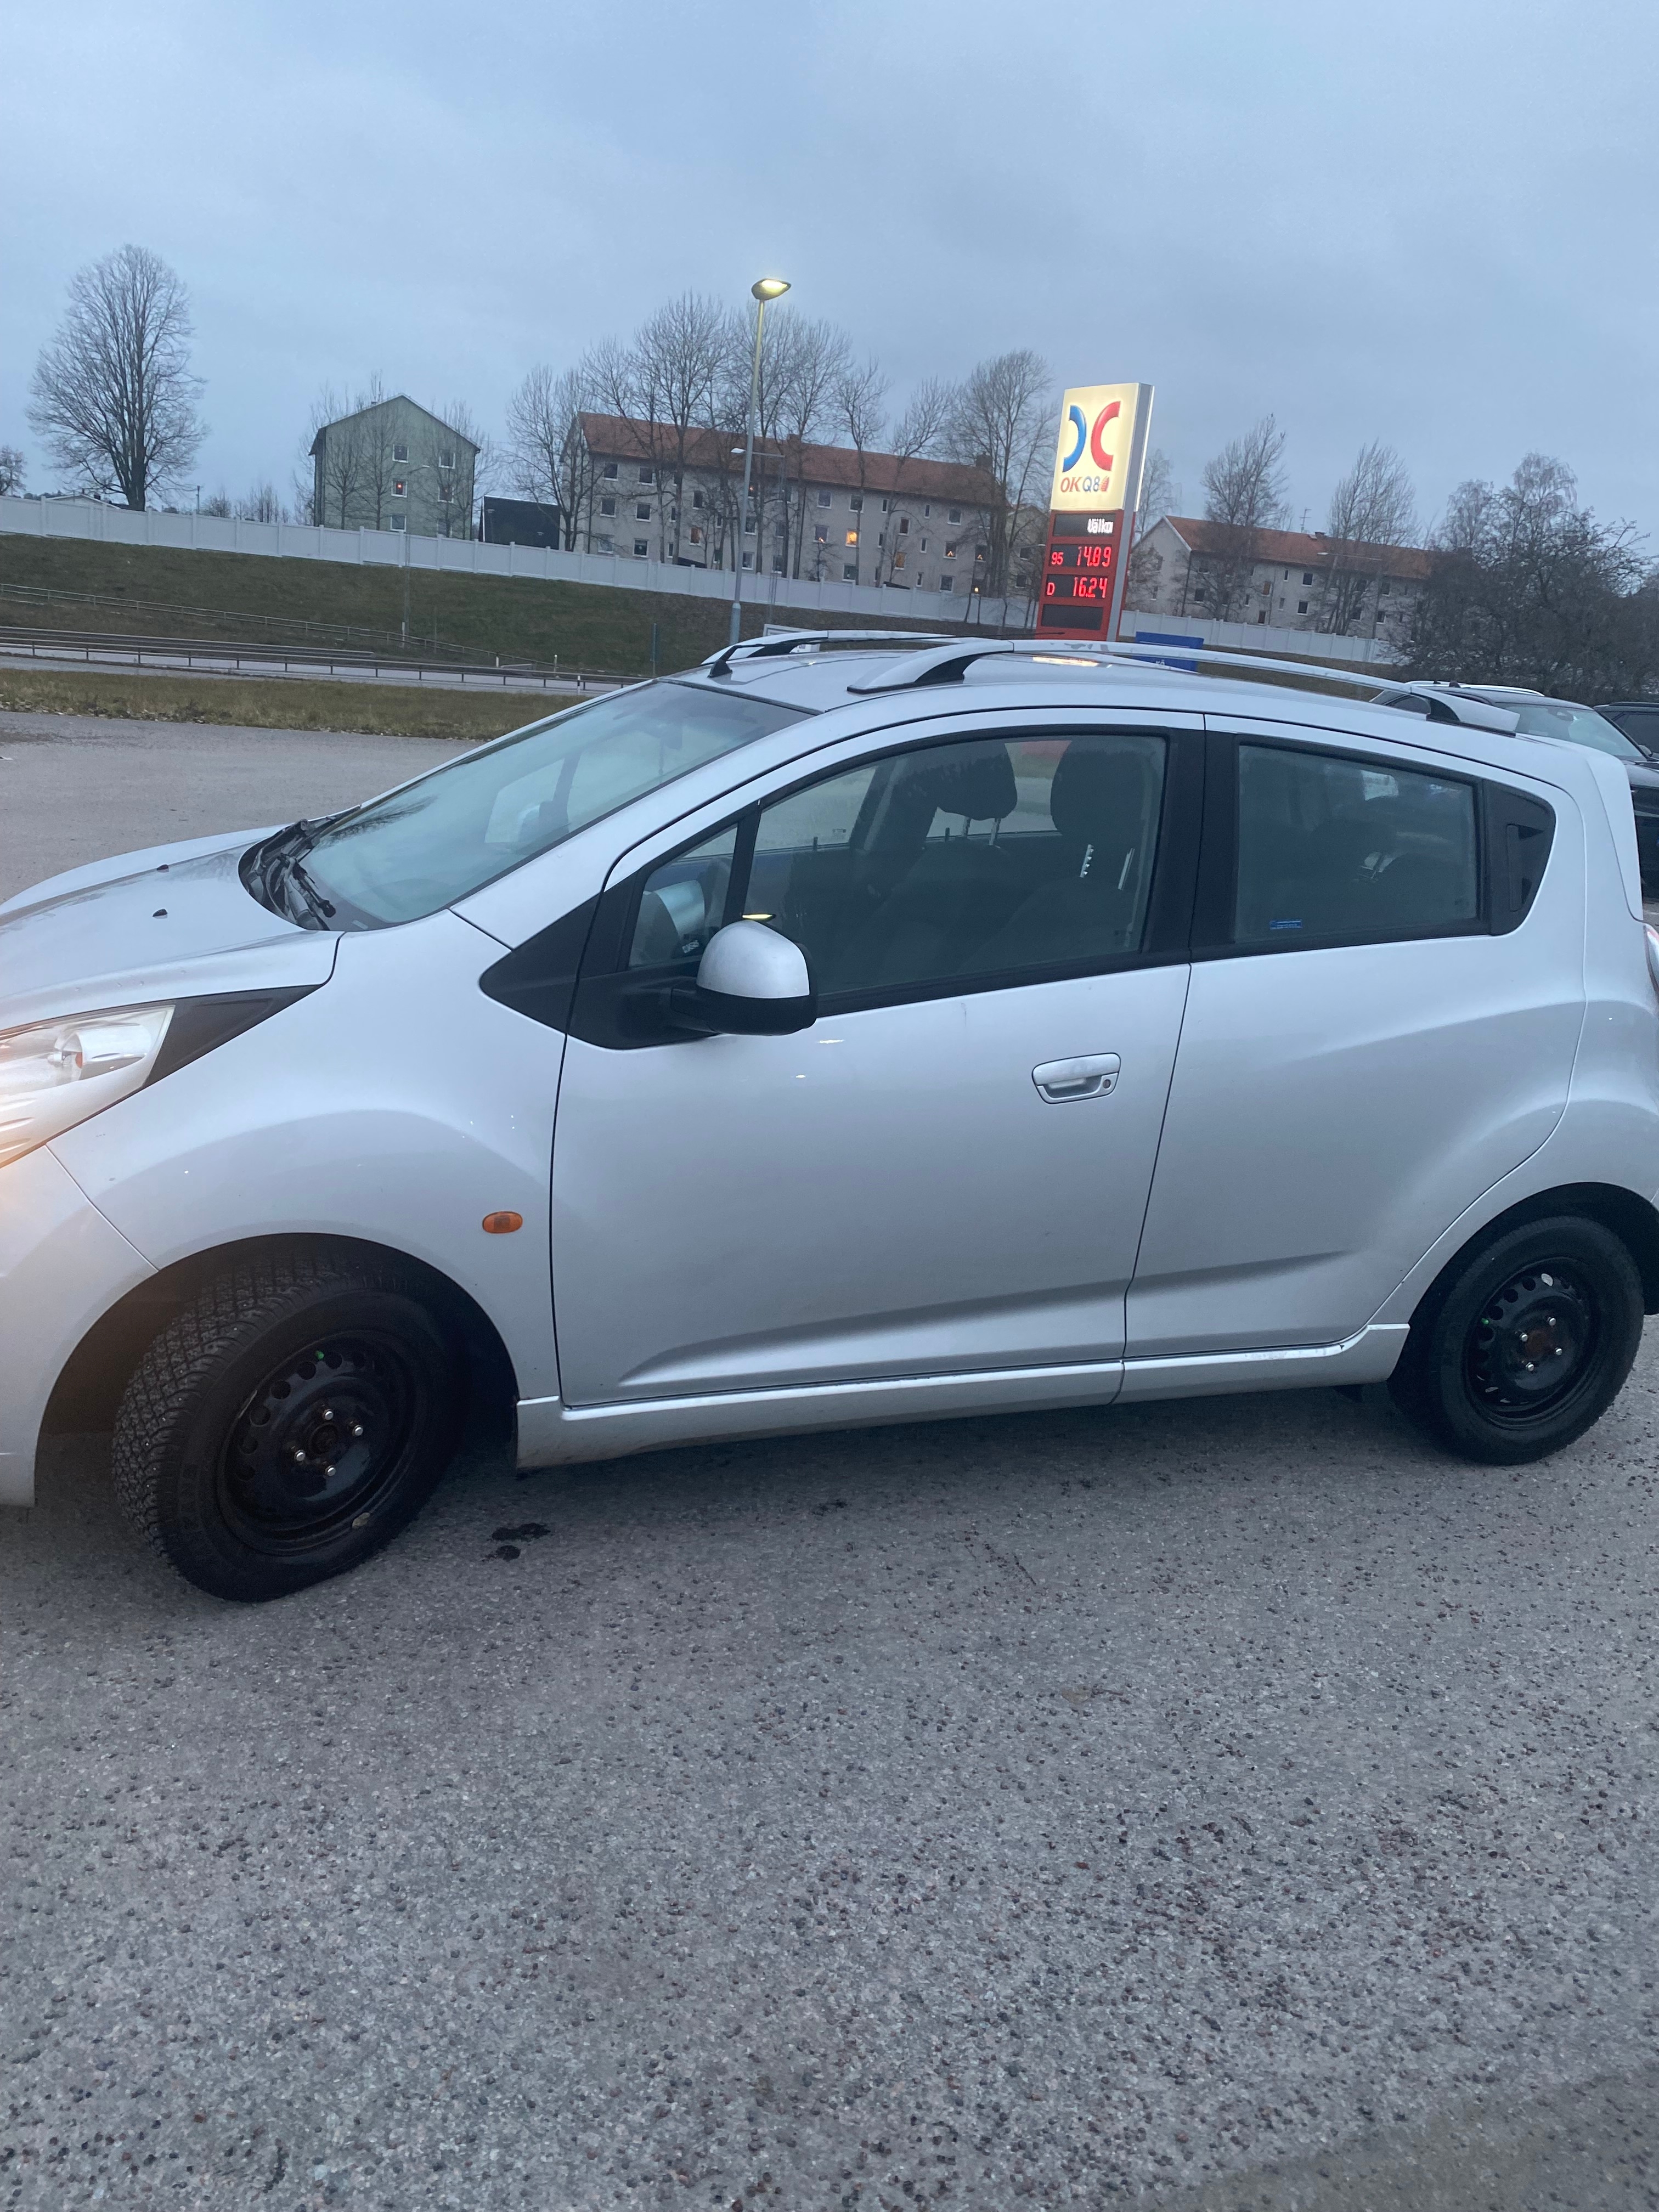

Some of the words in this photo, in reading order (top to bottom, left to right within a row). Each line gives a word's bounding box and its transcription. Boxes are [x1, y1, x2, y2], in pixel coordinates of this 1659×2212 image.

[1087, 518, 1113, 533] Välko
[1052, 552, 1064, 565] 95
[1047, 582, 1055, 596] D
[1073, 577, 1108, 598] 16.24
